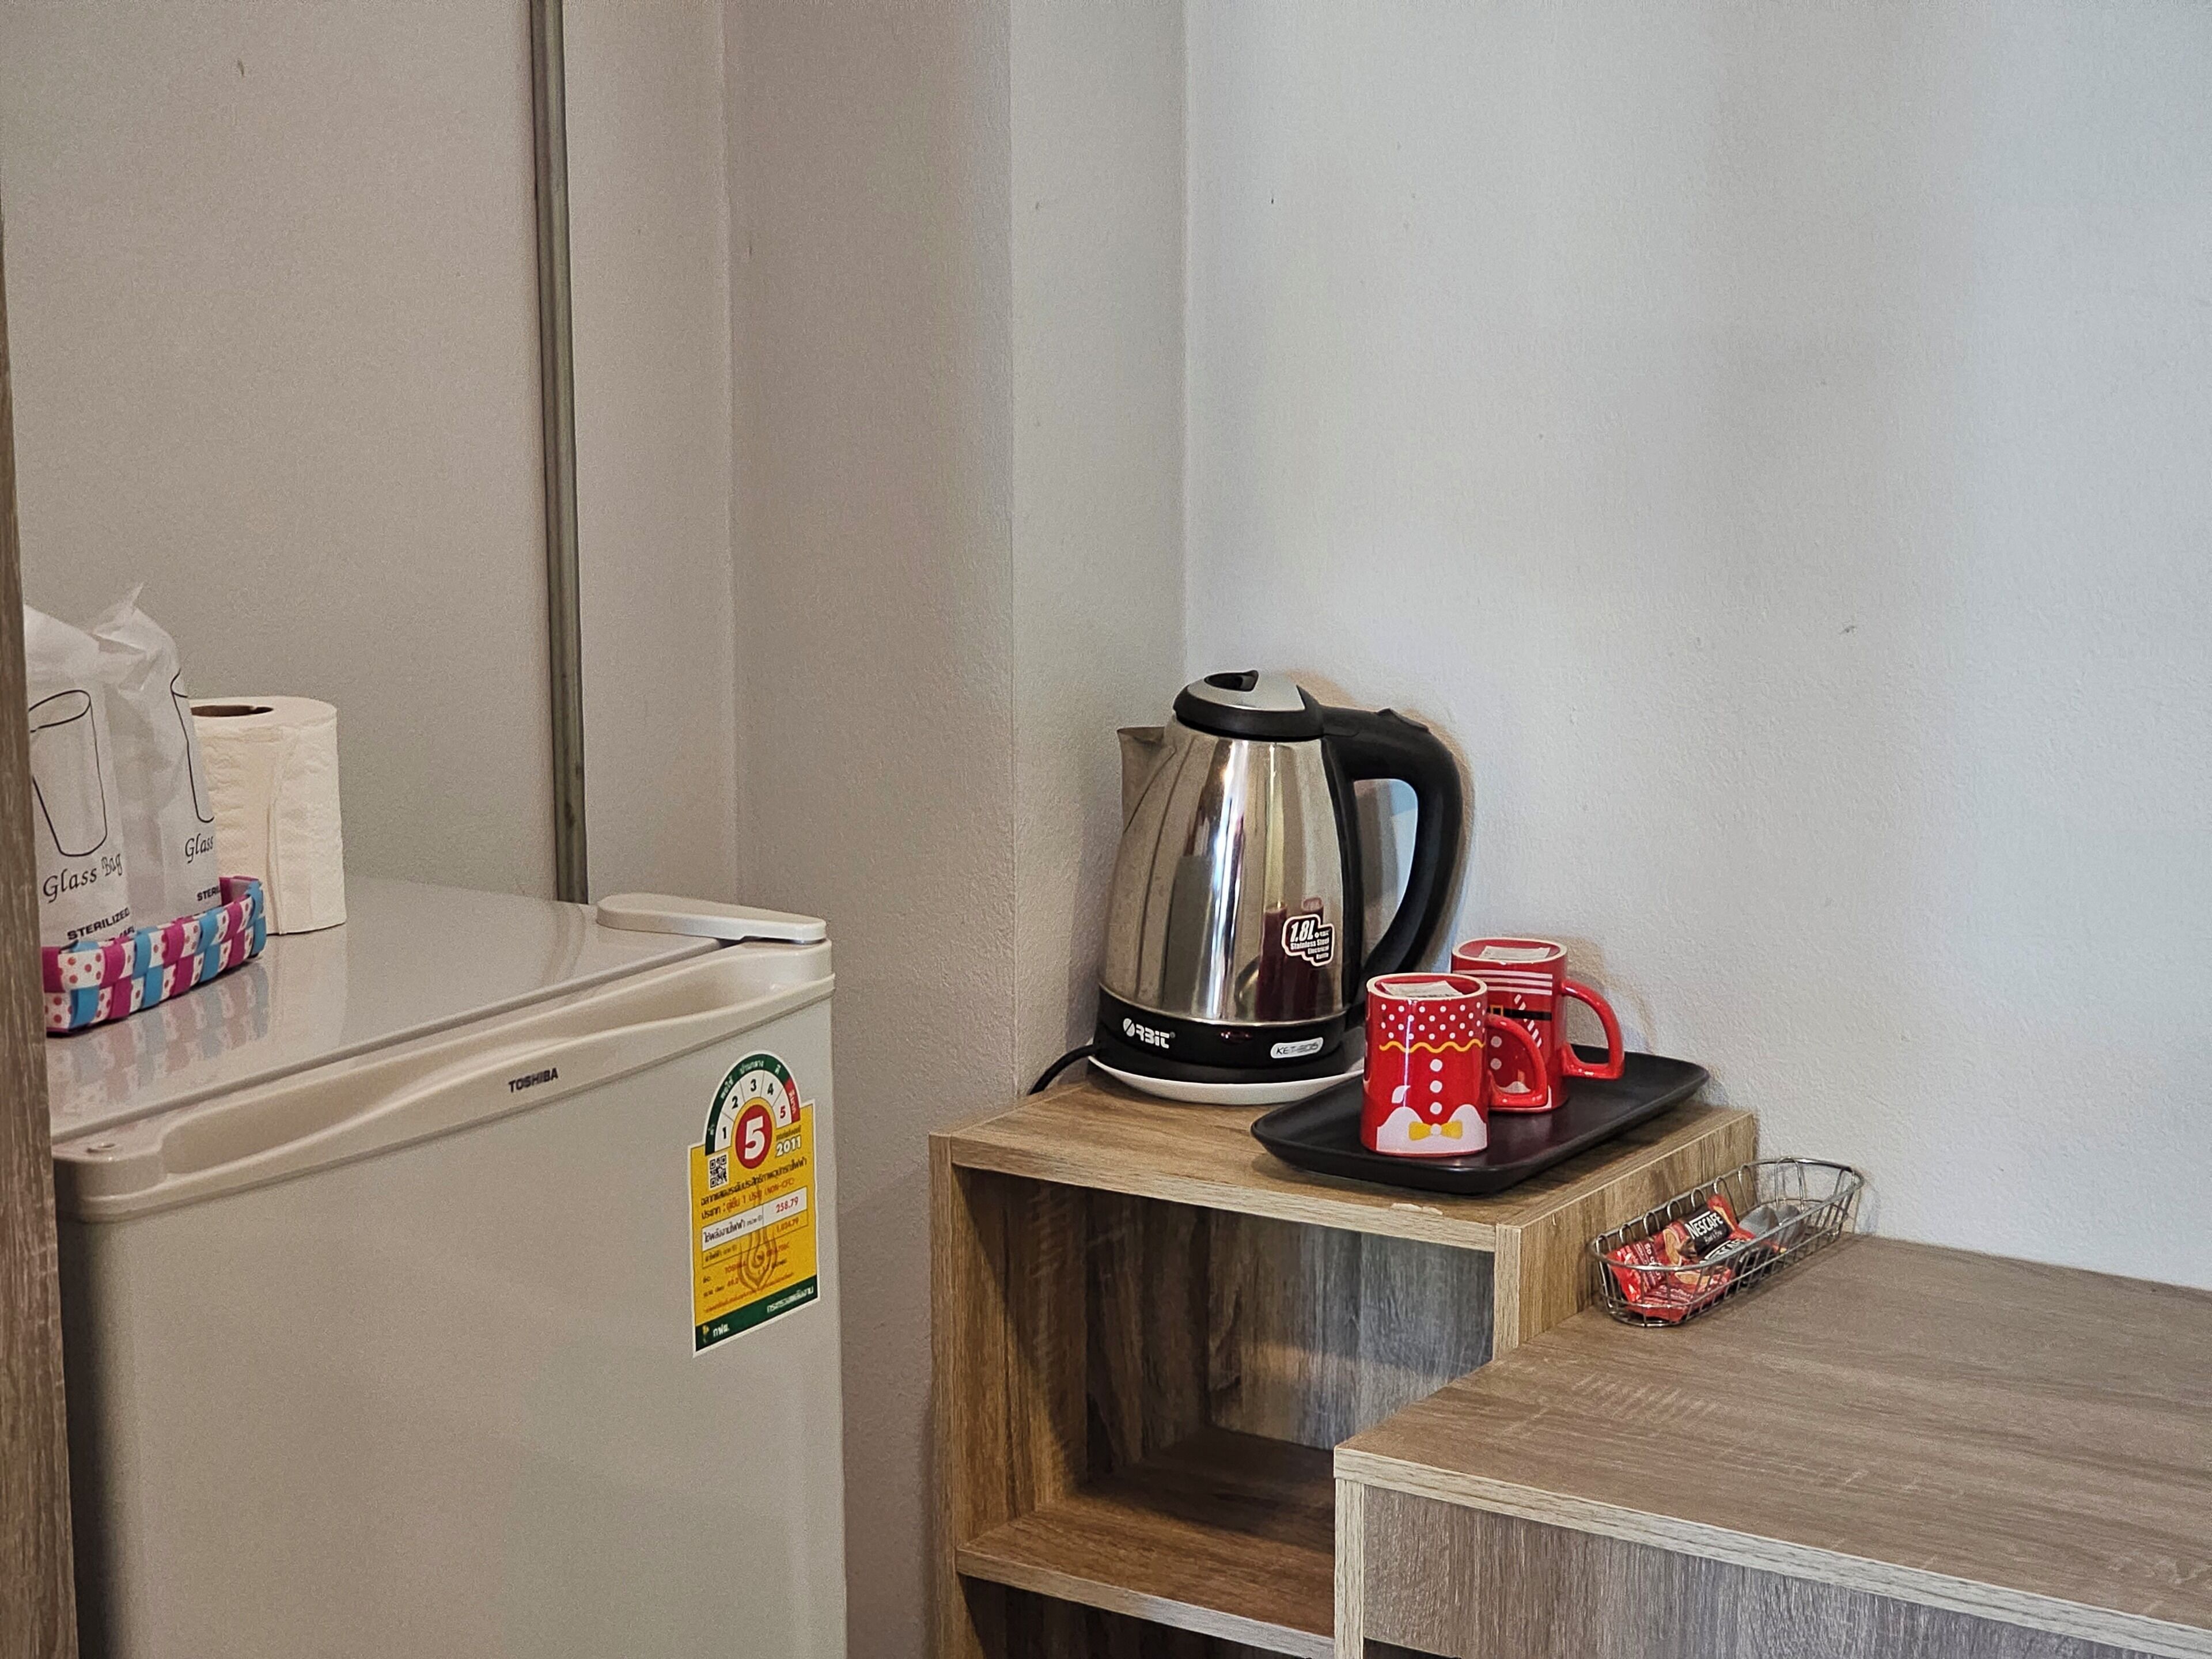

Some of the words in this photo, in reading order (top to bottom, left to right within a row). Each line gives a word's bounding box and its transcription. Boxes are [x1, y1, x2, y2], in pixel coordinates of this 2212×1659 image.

[185, 833, 213, 863] Glass
[43, 868, 97, 903] Glass
[101, 853, 123, 876] Bag
[67, 907, 130, 940] STERILIZED
[1290, 920, 1315, 942] 1.8L
[1290, 941, 1316, 950] Stainless
[508, 1067, 558, 1093] TOSHIBA
[722, 1126, 727, 1139] 1
[732, 1096, 738, 1109] 2
[750, 1079, 757, 1092] 3
[767, 1083, 774, 1095] 4
[780, 1105, 786, 1119] 5
[744, 1116, 765, 1160] 5
[775, 1136, 801, 1157] 2011
[775, 1196, 799, 1213] 258.79
